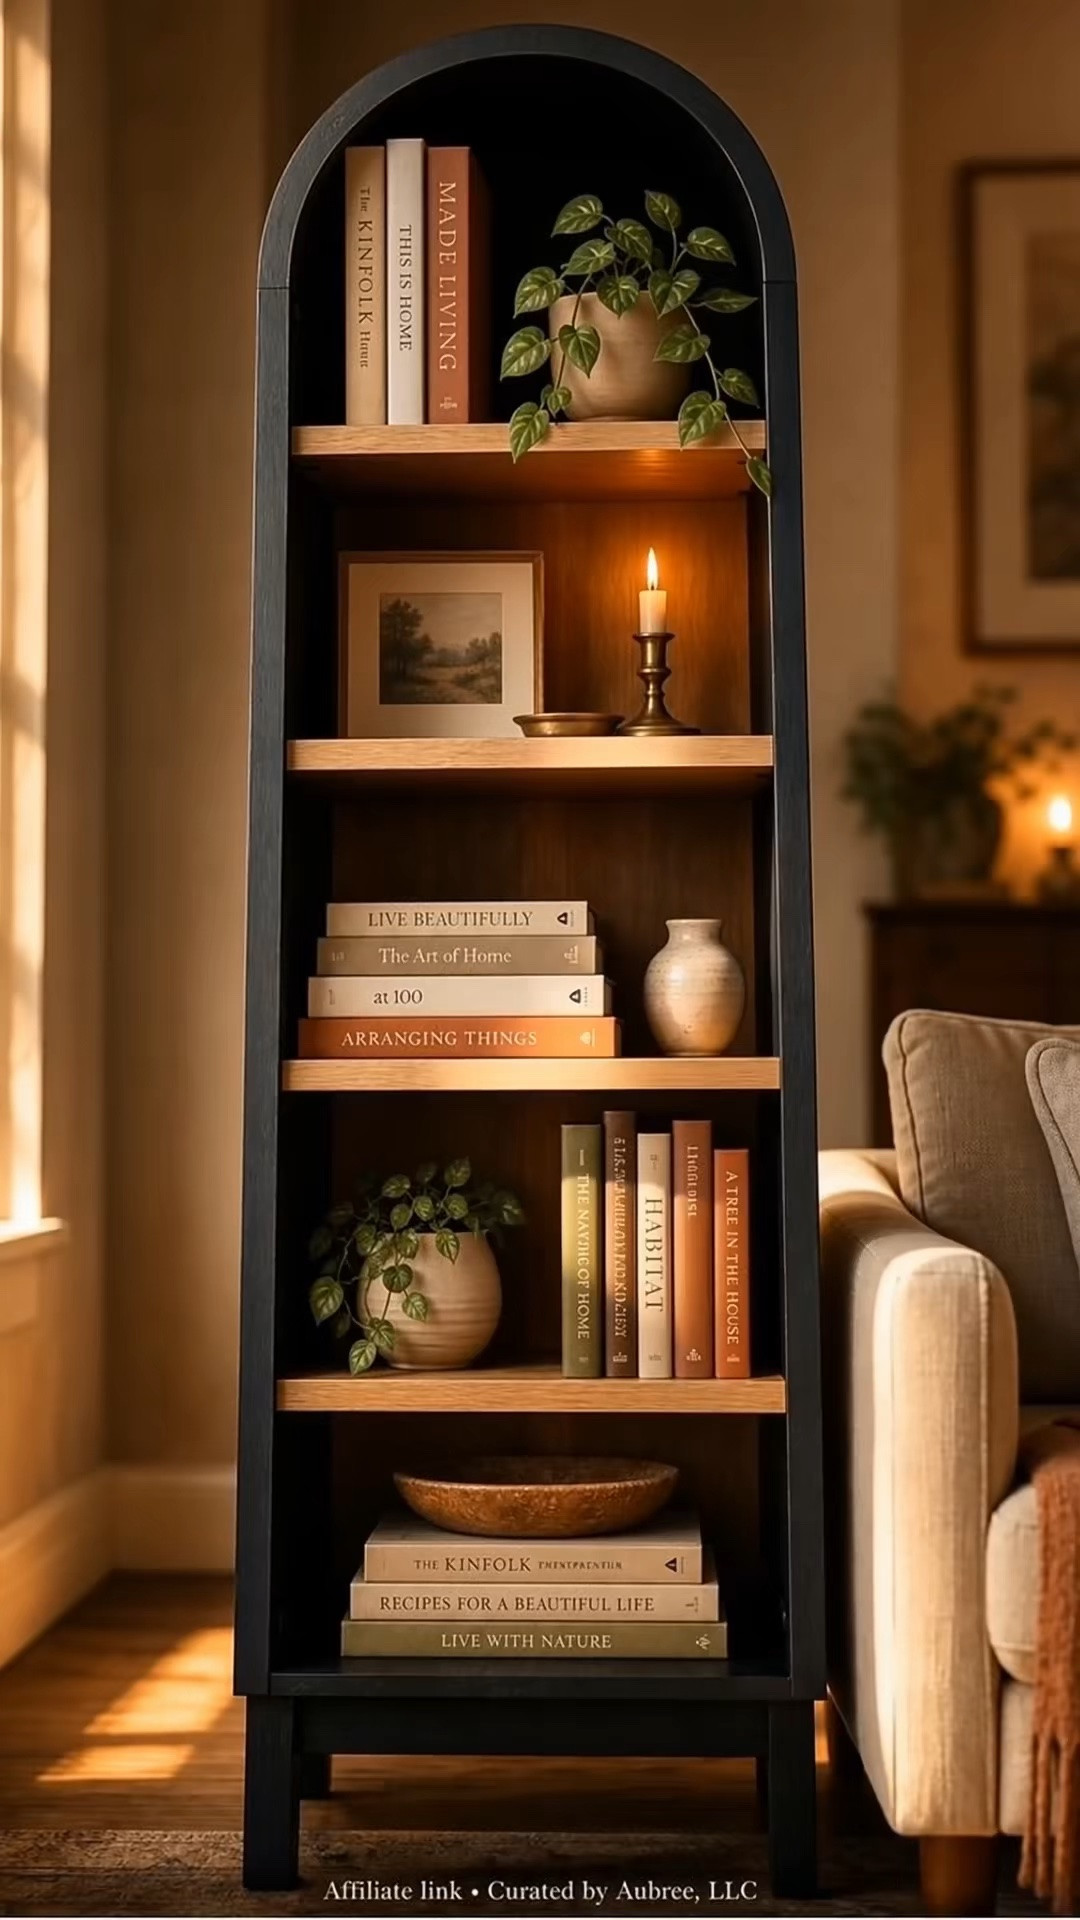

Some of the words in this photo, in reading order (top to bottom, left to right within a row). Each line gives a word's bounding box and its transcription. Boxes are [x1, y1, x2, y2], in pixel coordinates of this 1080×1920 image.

[439, 182, 457, 265] MADE
[399, 224, 412, 268] THIS
[358, 219, 373, 324] KINFOLK
[399, 272, 412, 290] IS
[399, 296, 412, 352] HOME
[439, 276, 457, 371] LIVING
[368, 912, 408, 927] LIVE
[413, 911, 534, 927] BEAUTIFULLY
[378, 948, 409, 963] The
[412, 948, 438, 963] Art
[443, 948, 460, 963] of
[463, 948, 512, 964] Home
[373, 990, 390, 1005] at
[394, 989, 423, 1005] 100
[341, 1031, 458, 1047] ARRANGING
[464, 1031, 538, 1047] THINGS
[577, 1173, 590, 1206] THE
[726, 1171, 738, 1183] A
[726, 1187, 739, 1226] TREE
[726, 1231, 739, 1249] IN
[645, 1198, 663, 1313] HABITAT
[726, 1252, 739, 1286] THE
[577, 1267, 590, 1289] OF
[577, 1292, 590, 1340] HOME
[726, 1291, 739, 1345] HOUSE
[414, 1560, 439, 1570] THE
[444, 1557, 532, 1573] KINFOLK
[380, 1596, 452, 1612] RECIPES
[457, 1596, 492, 1611] FOR
[497, 1597, 508, 1611] A
[514, 1596, 611, 1612] BEAUTIFUL
[616, 1597, 656, 1612] LIFE
[441, 1633, 481, 1649] LIVE
[488, 1633, 534, 1649] WITH
[541, 1633, 612, 1649] NATURE
